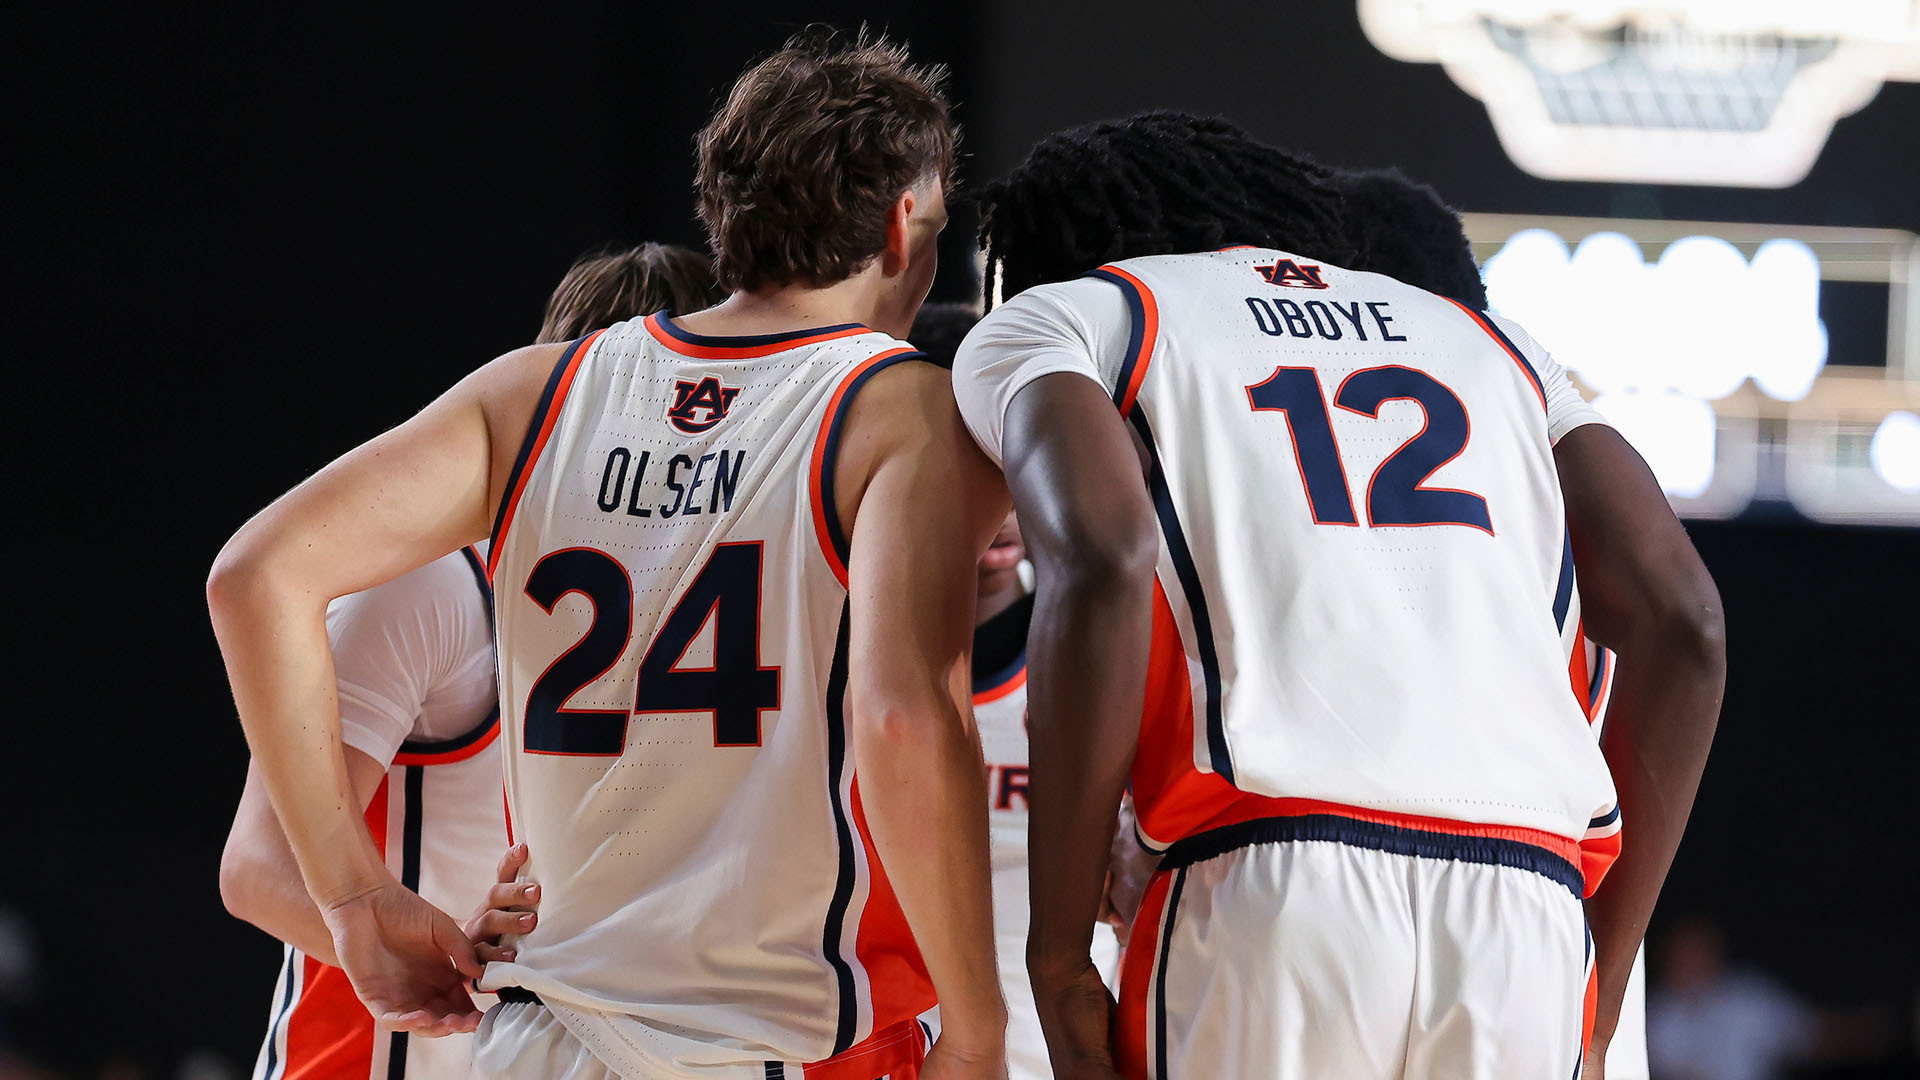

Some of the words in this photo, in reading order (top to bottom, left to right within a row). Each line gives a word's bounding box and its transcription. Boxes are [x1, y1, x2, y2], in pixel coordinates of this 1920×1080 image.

[1245, 297, 1408, 342] OBOYE
[597, 447, 747, 518] OLSEN
[1244, 364, 1496, 537] 12
[523, 540, 781, 757] 24
